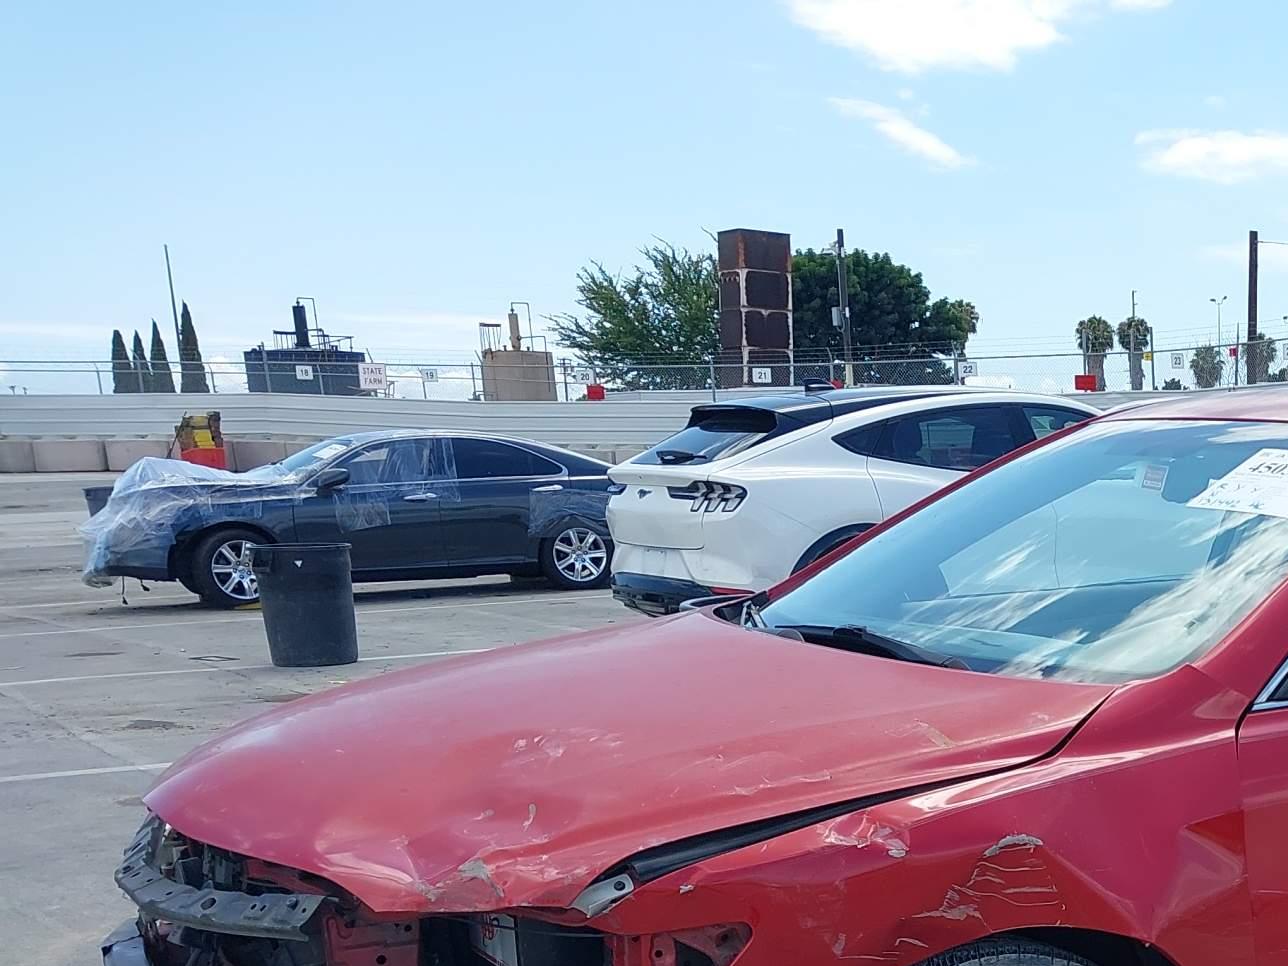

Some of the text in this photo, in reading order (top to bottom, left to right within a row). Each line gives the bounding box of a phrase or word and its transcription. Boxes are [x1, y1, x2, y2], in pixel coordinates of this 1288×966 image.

[1173, 356, 1182, 365] 23
[300, 369, 309, 377] 18
[362, 367, 383, 376] STATE
[963, 365, 973, 374] 22
[425, 371, 434, 379] 19
[580, 373, 589, 381] 20
[757, 371, 767, 380] 21
[364, 377, 383, 385] FARM
